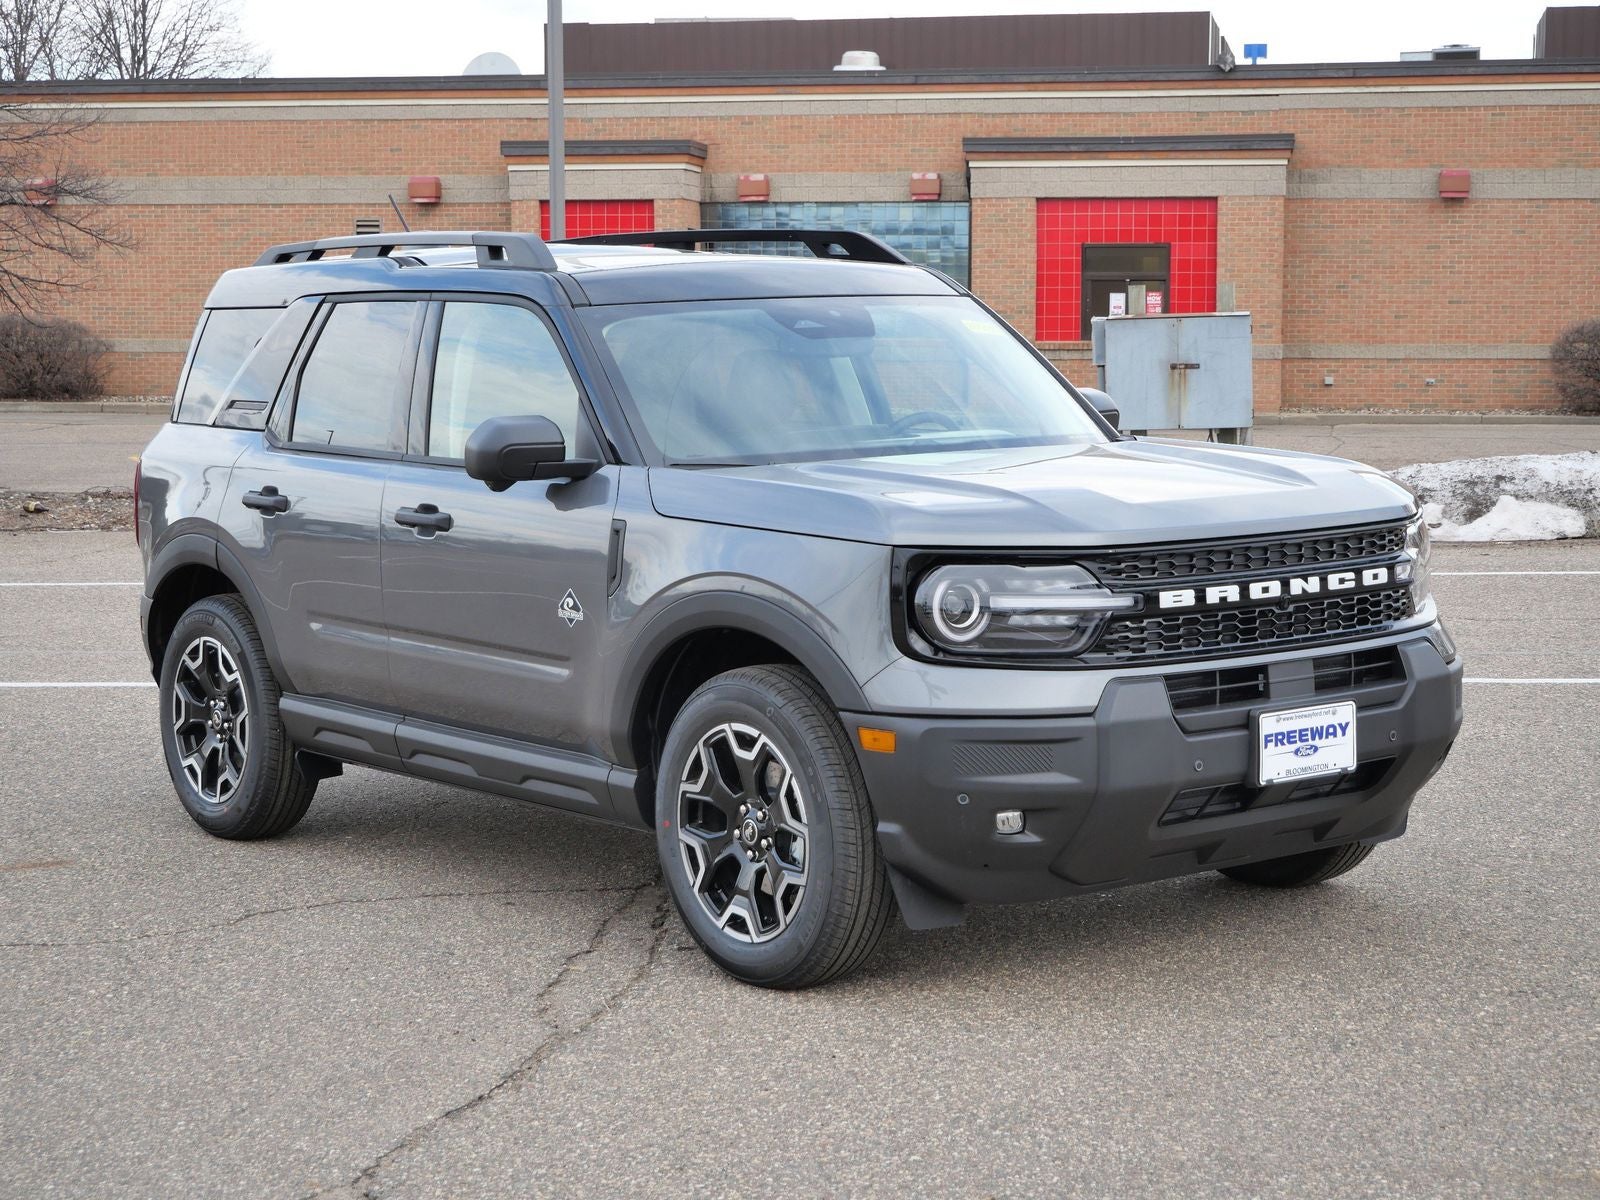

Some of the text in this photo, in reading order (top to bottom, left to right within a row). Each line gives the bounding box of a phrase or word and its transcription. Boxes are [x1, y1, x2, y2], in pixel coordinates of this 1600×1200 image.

[1158, 567, 1389, 609] BRONCO
[1263, 721, 1350, 749] FREEWAY
[1296, 745, 1317, 757] Ford
[1285, 763, 1328, 776] BLOOMINGTON
